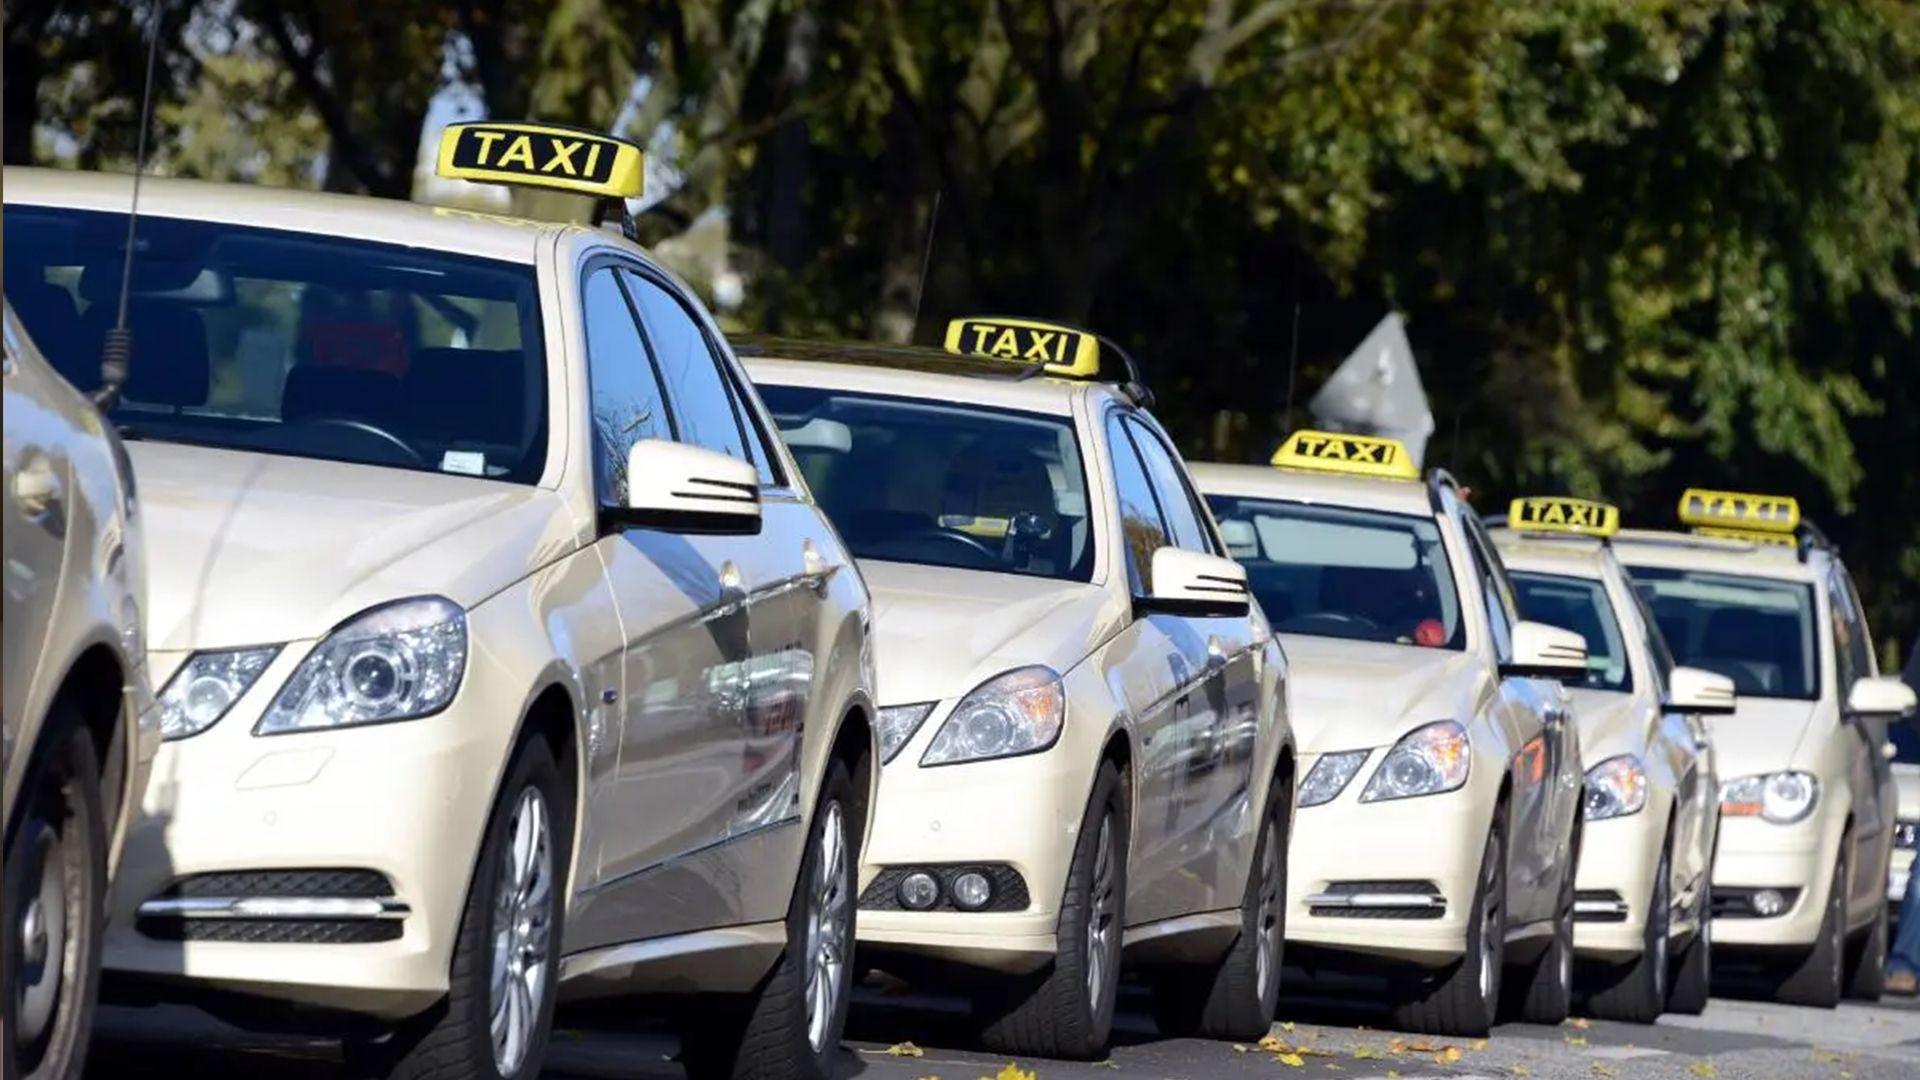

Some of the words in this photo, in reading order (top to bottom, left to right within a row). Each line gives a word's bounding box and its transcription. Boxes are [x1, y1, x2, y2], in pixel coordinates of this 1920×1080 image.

[473, 131, 601, 177] TAXI
[972, 324, 1068, 362] TAXI
[1299, 437, 1394, 465] TAXI
[1527, 500, 1598, 527] TAXI
[1698, 495, 1777, 519] TAXI
